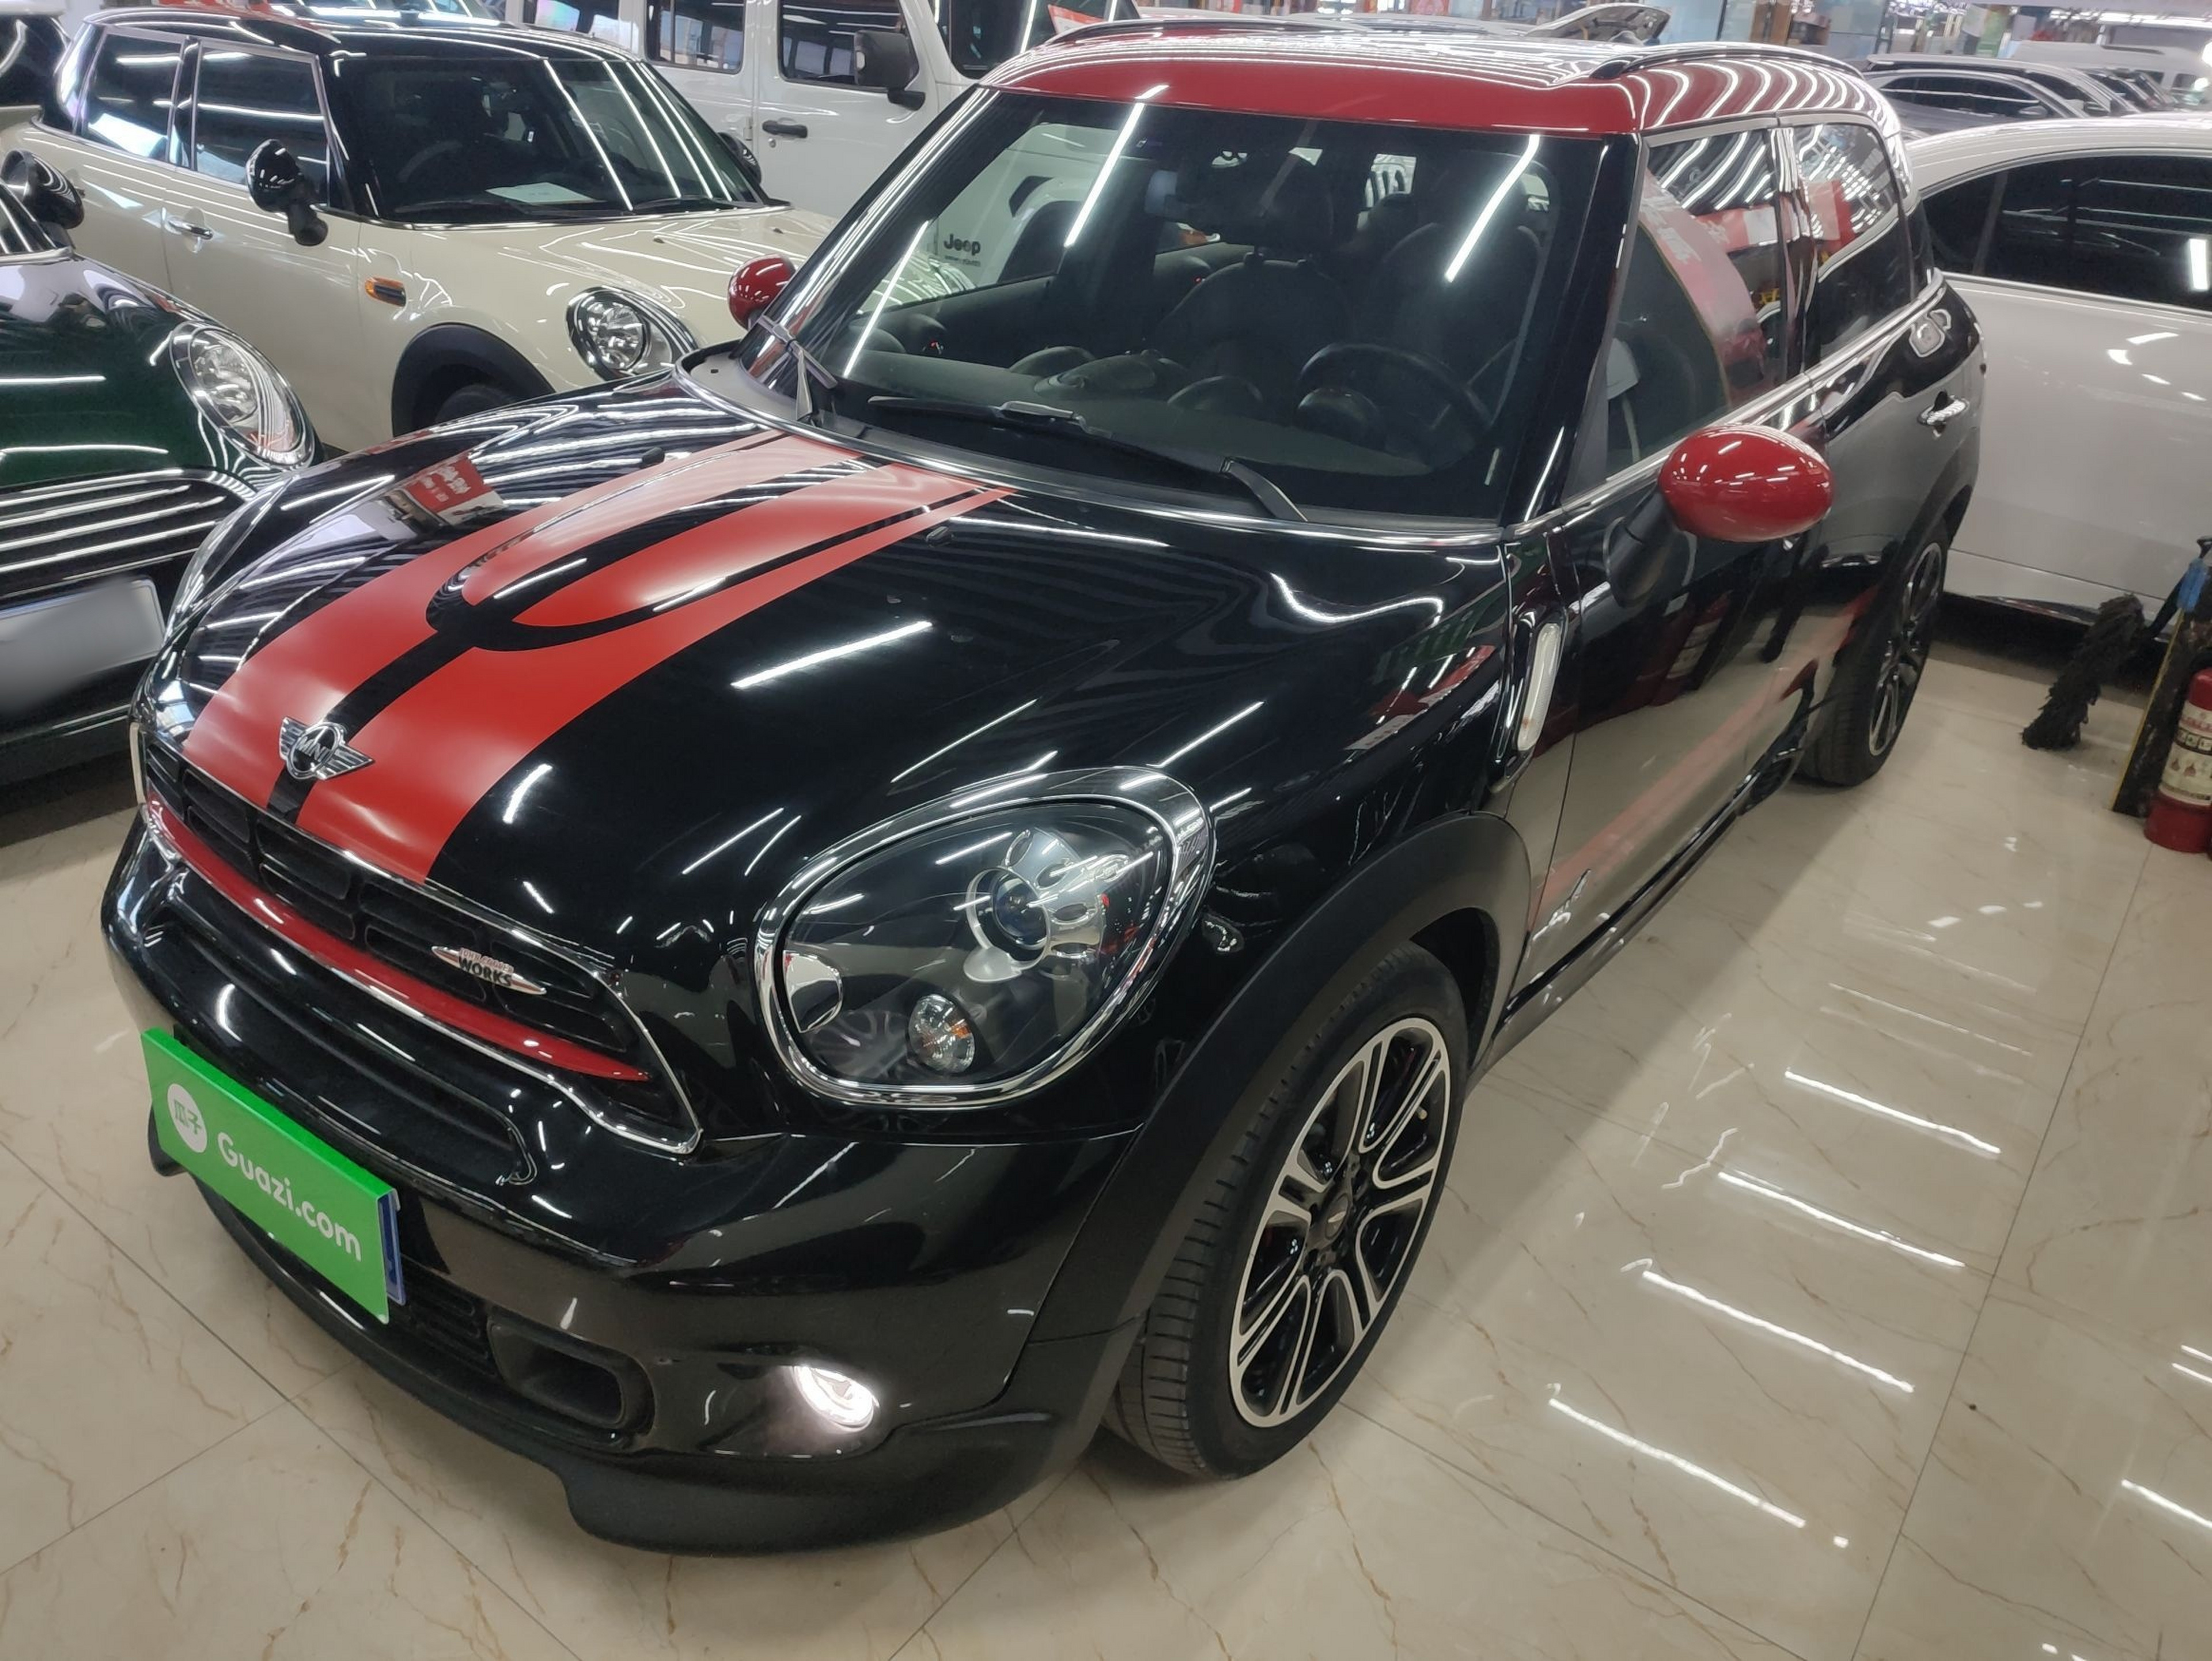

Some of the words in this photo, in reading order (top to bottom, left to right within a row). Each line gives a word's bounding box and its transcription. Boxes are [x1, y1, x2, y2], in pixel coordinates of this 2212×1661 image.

[943, 233, 981, 256] Jeep
[294, 736, 332, 763] MINI
[459, 956, 512, 987] WORKS
[173, 1098, 203, 1136] 瓜子
[217, 1132, 362, 1262] Guazi.com
